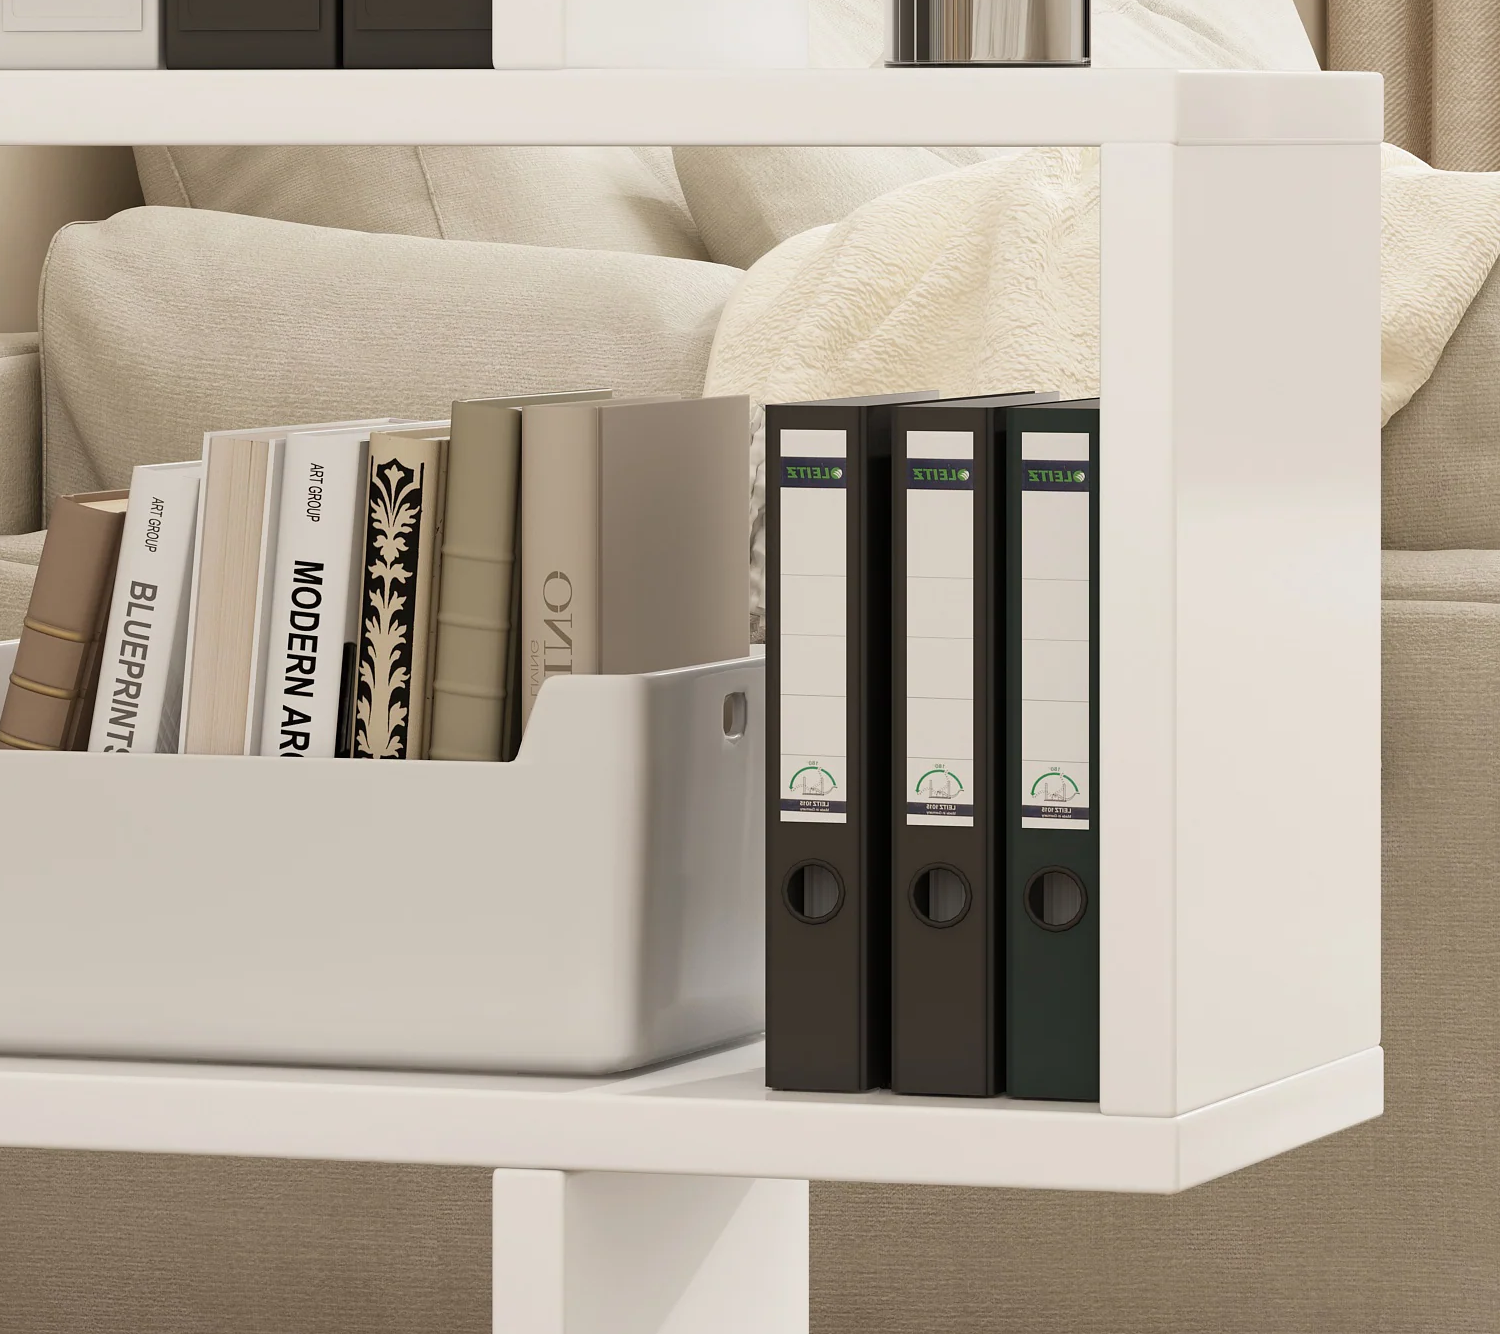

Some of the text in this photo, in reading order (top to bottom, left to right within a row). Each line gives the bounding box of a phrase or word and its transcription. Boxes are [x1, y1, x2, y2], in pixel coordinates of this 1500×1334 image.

[307, 463, 324, 522] ART GROUP
[145, 497, 164, 552] ART GROUP
[284, 561, 324, 697] MODERN
